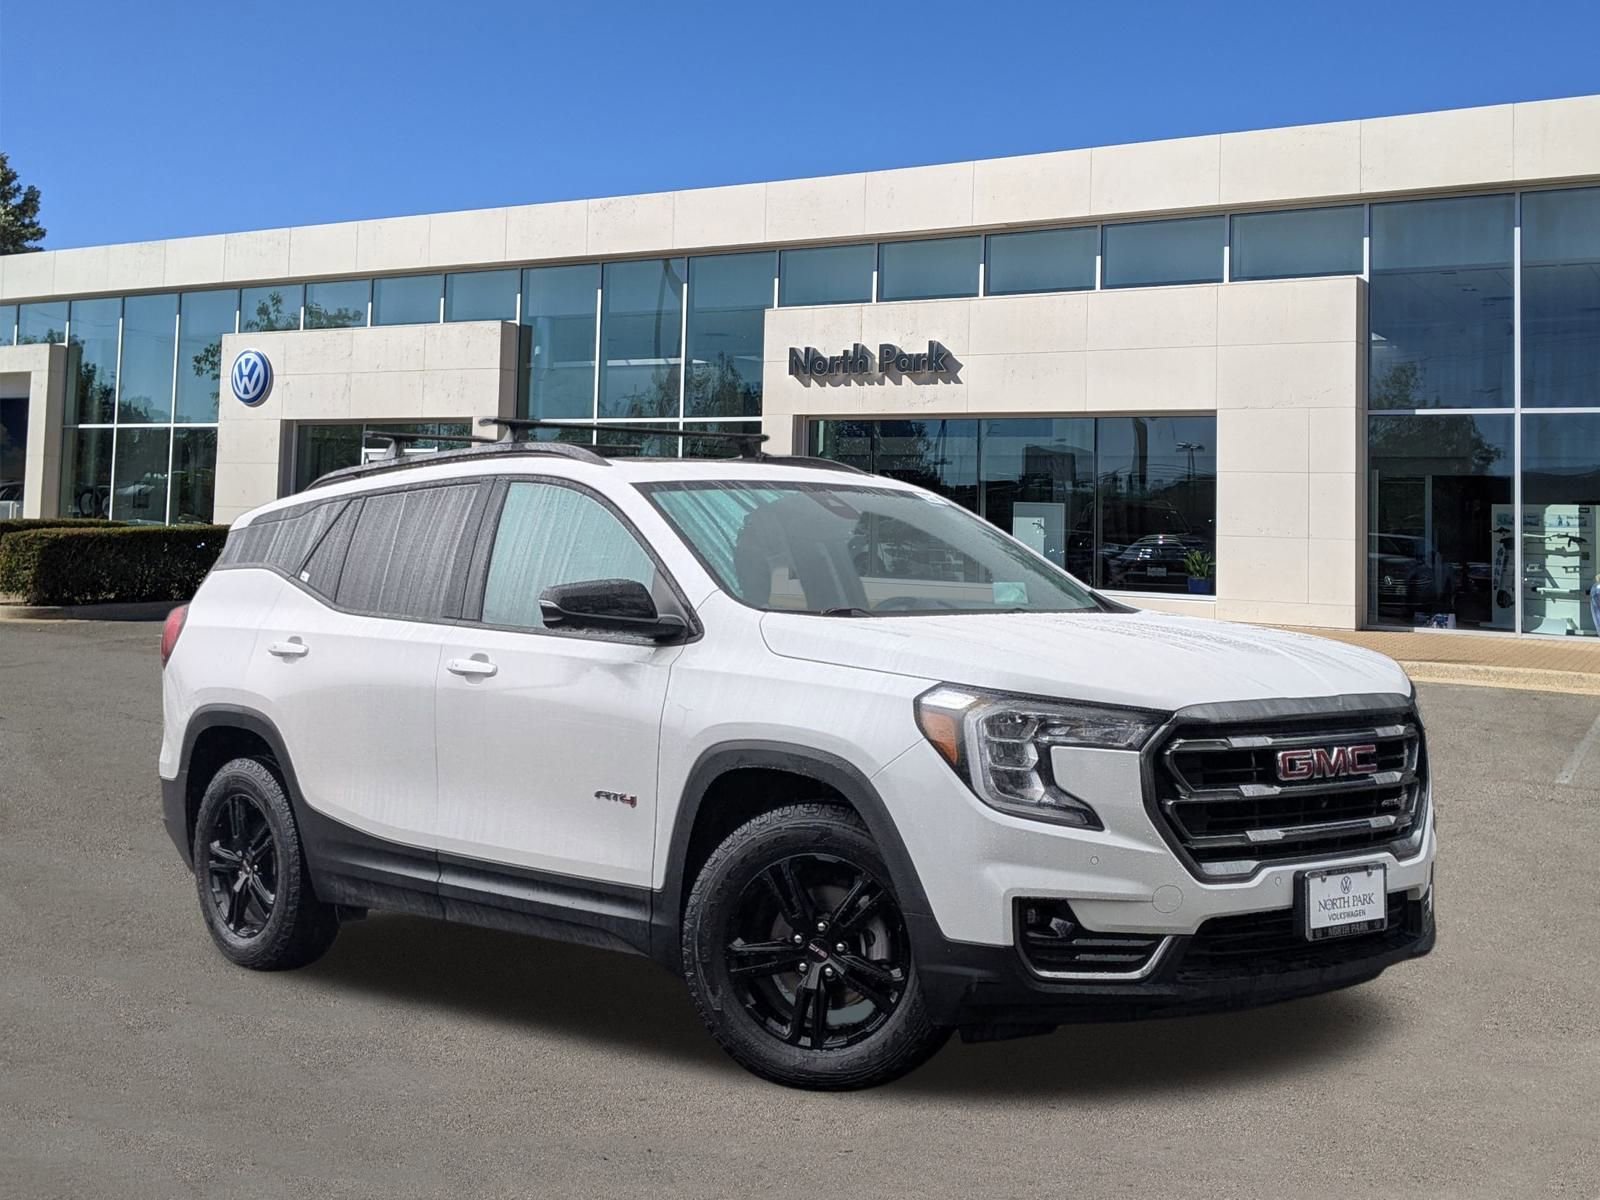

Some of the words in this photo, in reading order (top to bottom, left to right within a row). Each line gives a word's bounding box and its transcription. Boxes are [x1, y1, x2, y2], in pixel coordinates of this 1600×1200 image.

[788, 343, 873, 376] North
[878, 340, 947, 373] Park
[232, 351, 269, 403] VW
[1277, 744, 1377, 781] GMC
[1318, 896, 1350, 912] NORTH
[1352, 893, 1375, 907] PARK
[1328, 909, 1366, 921] VOLKSWAGEN
